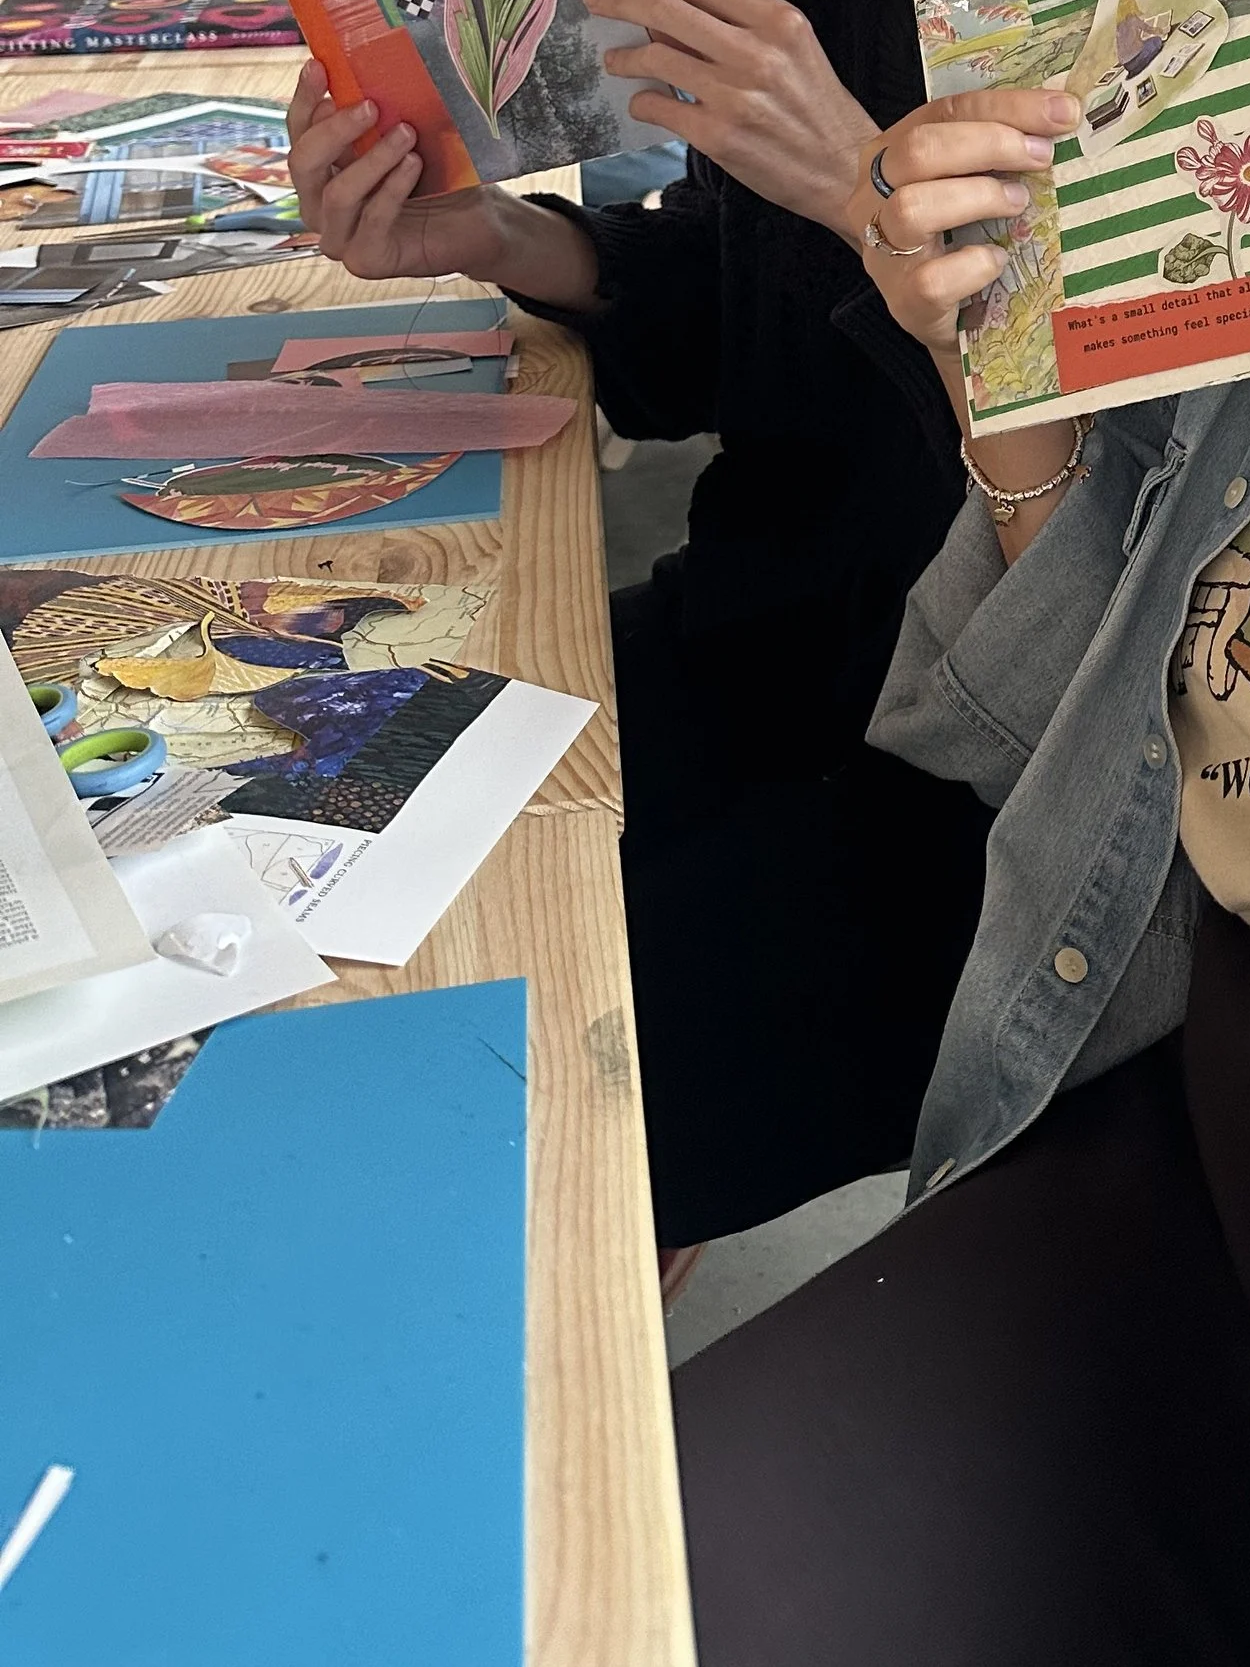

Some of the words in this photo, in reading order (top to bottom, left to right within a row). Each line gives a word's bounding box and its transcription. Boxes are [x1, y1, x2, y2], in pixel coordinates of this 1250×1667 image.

[0, 37, 76, 52] ILTING
[86, 30, 218, 49] MASTERCLASS
[1067, 314, 1106, 331] What's
[1111, 313, 1118, 321] a
[1123, 302, 1156, 319] small
[1161, 292, 1200, 311] detail
[1206, 286, 1232, 300] that
[1083, 338, 1116, 353] makes
[1121, 325, 1178, 344] something
[1184, 316, 1210, 331] feel
[342, 838, 373, 868] PIECING
[317, 867, 348, 898] CURVED
[295, 897, 322, 923] SEAMS
